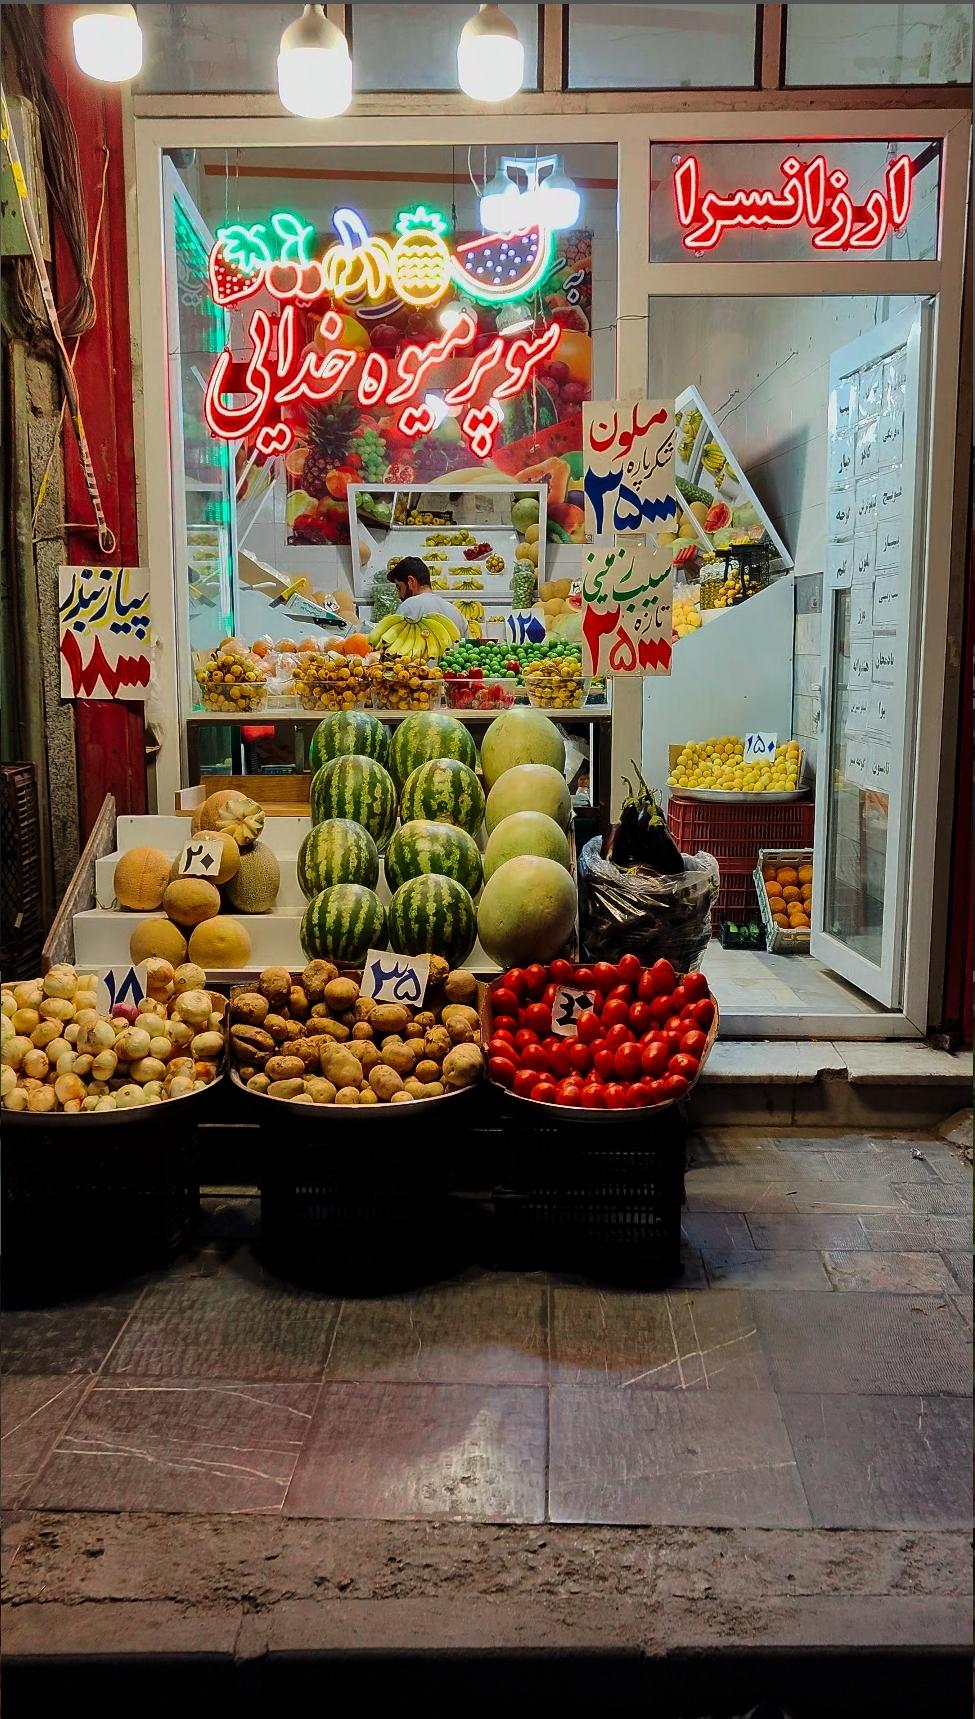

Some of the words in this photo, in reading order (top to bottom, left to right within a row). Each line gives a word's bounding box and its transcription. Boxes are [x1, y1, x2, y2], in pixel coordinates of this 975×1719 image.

[205, 306, 356, 455] خدایی
[358, 312, 476, 436] میوه
[445, 323, 561, 457] سوپر
[589, 402, 668, 462] ملون
[583, 549, 635, 604] زمینی
[612, 564, 672, 613] سیب
[88, 568, 150, 640] پیاز
[634, 605, 670, 635] تازه
[747, 735, 775, 754] ۱۵۰
[183, 845, 215, 873] ۲۰
[103, 967, 145, 1014] ۱۸
[370, 959, 421, 1001] ۳۵
